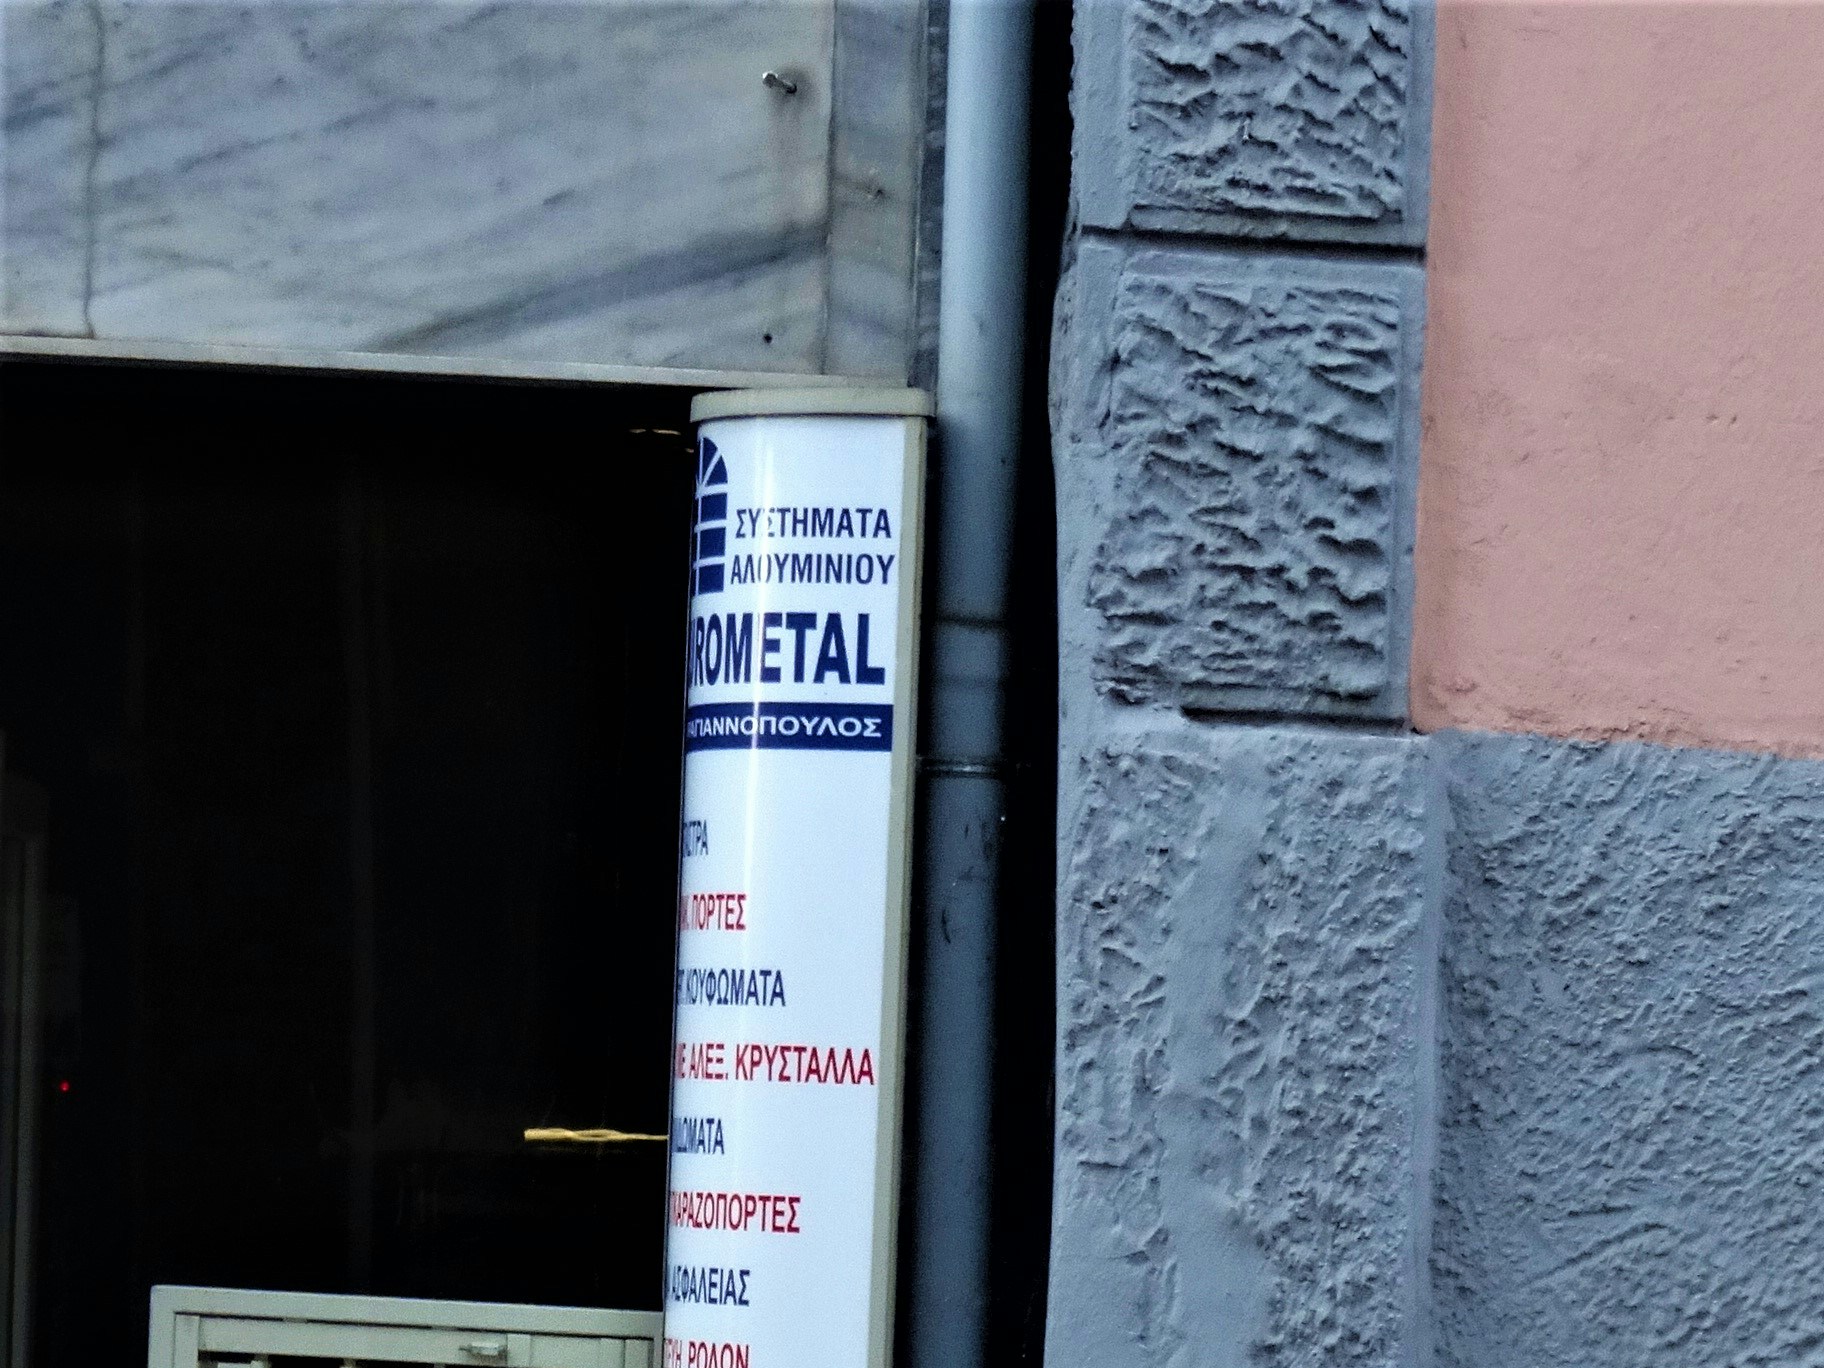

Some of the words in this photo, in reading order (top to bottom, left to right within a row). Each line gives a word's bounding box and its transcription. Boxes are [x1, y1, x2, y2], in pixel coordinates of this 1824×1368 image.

[735, 507, 892, 538] ΣΥΣΤΗΜΑΤΑ
[730, 553, 896, 585] ΑΛΟΥΜΙΝΙΟΥ
[735, 1043, 875, 1086] ΚΡΥΣΤΑΛΛΑ
